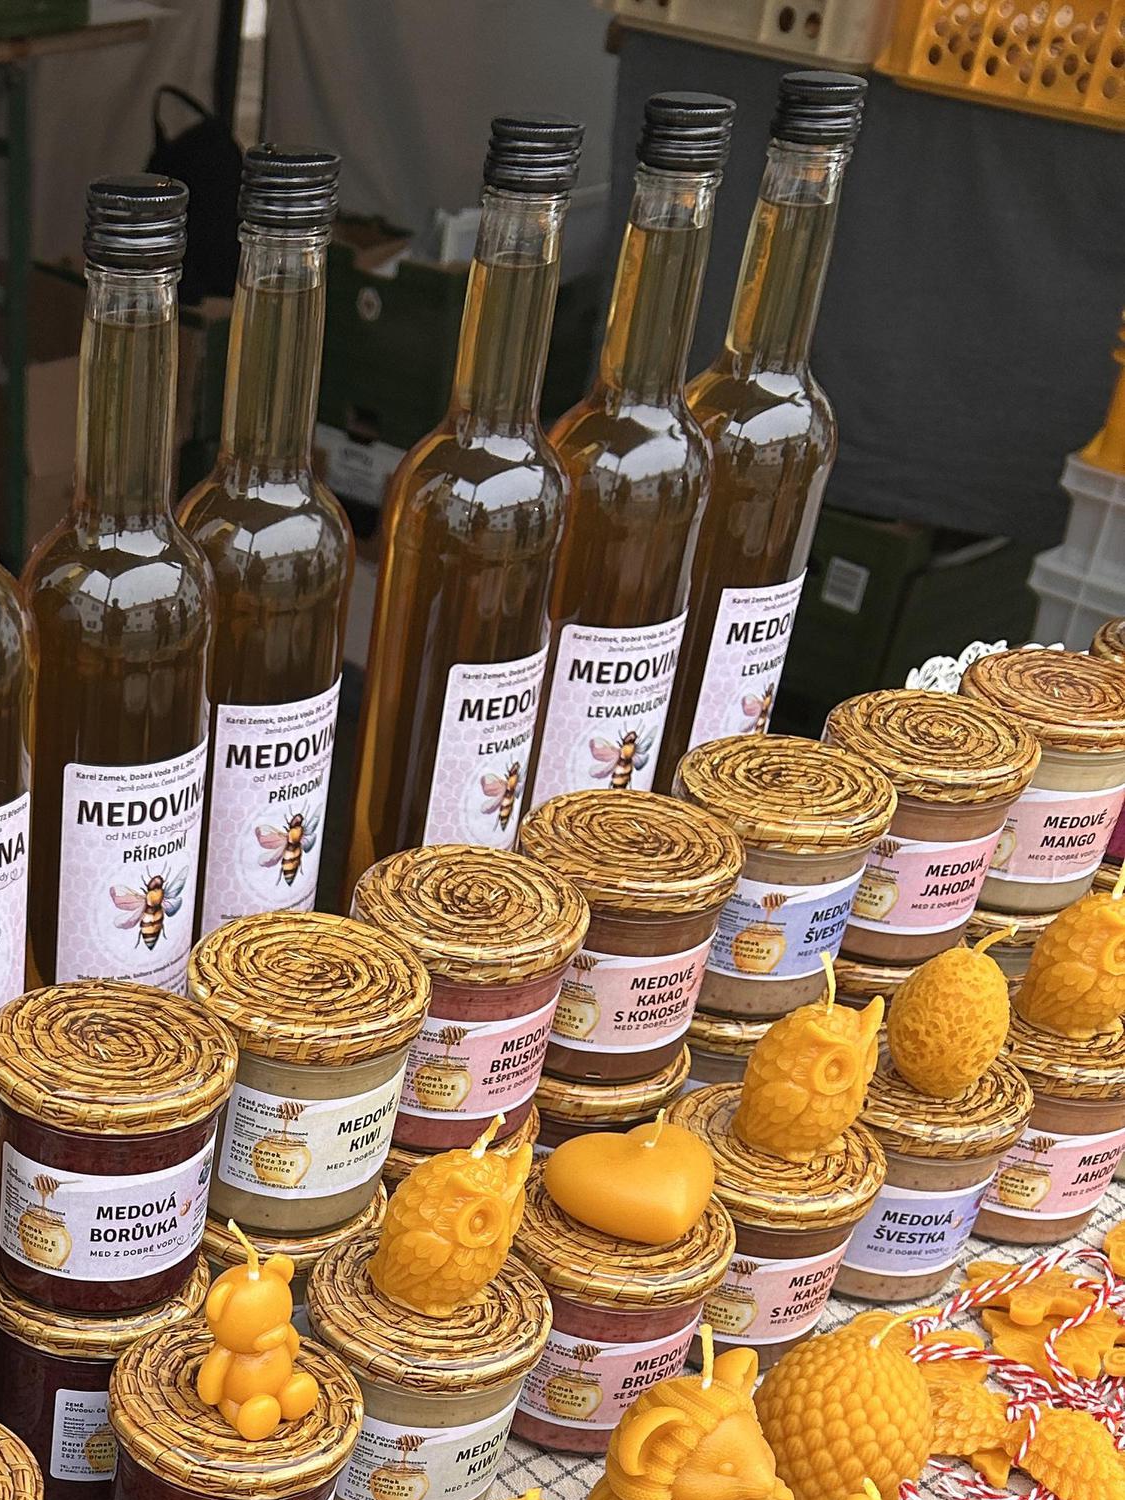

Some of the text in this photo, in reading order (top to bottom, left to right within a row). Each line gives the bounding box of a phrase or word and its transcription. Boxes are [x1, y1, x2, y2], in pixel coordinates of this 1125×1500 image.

[76, 772, 153, 782] Karel Zemek, Dobrá
[1044, 808, 1107, 828] MEDOVÉ
[123, 830, 188, 863] PŘÍRODNÍ
[1040, 832, 1096, 848] MANGO
[925, 852, 986, 877] MEDOVÁ
[920, 877, 976, 897] JAHODA
[630, 963, 695, 990] MEDOVÉ
[636, 987, 683, 1007] KAKAO
[614, 997, 689, 1023] S KOKOSEM
[482, 1077, 493, 1085] SE
[337, 1093, 395, 1136] MEDOVÉ
[232, 1140, 252, 1151] Karel
[349, 1126, 381, 1152] KIWI
[229, 1153, 253, 1166] 262 72
[326, 1161, 345, 1171] MED
[96, 1191, 177, 1220] MEDOVÁ
[882, 1209, 955, 1226] MEDOVÁ
[90, 1216, 178, 1243] BORŮVKA
[873, 1225, 946, 1244] ŠVESTKA
[90, 1250, 111, 1258] MED
[123, 1244, 154, 1257] DOBRÉ
[157, 1236, 177, 1251] VODY
[867, 1244, 884, 1252] MED
[770, 1308, 781, 1317] S
[467, 1449, 498, 1476] KIWI
